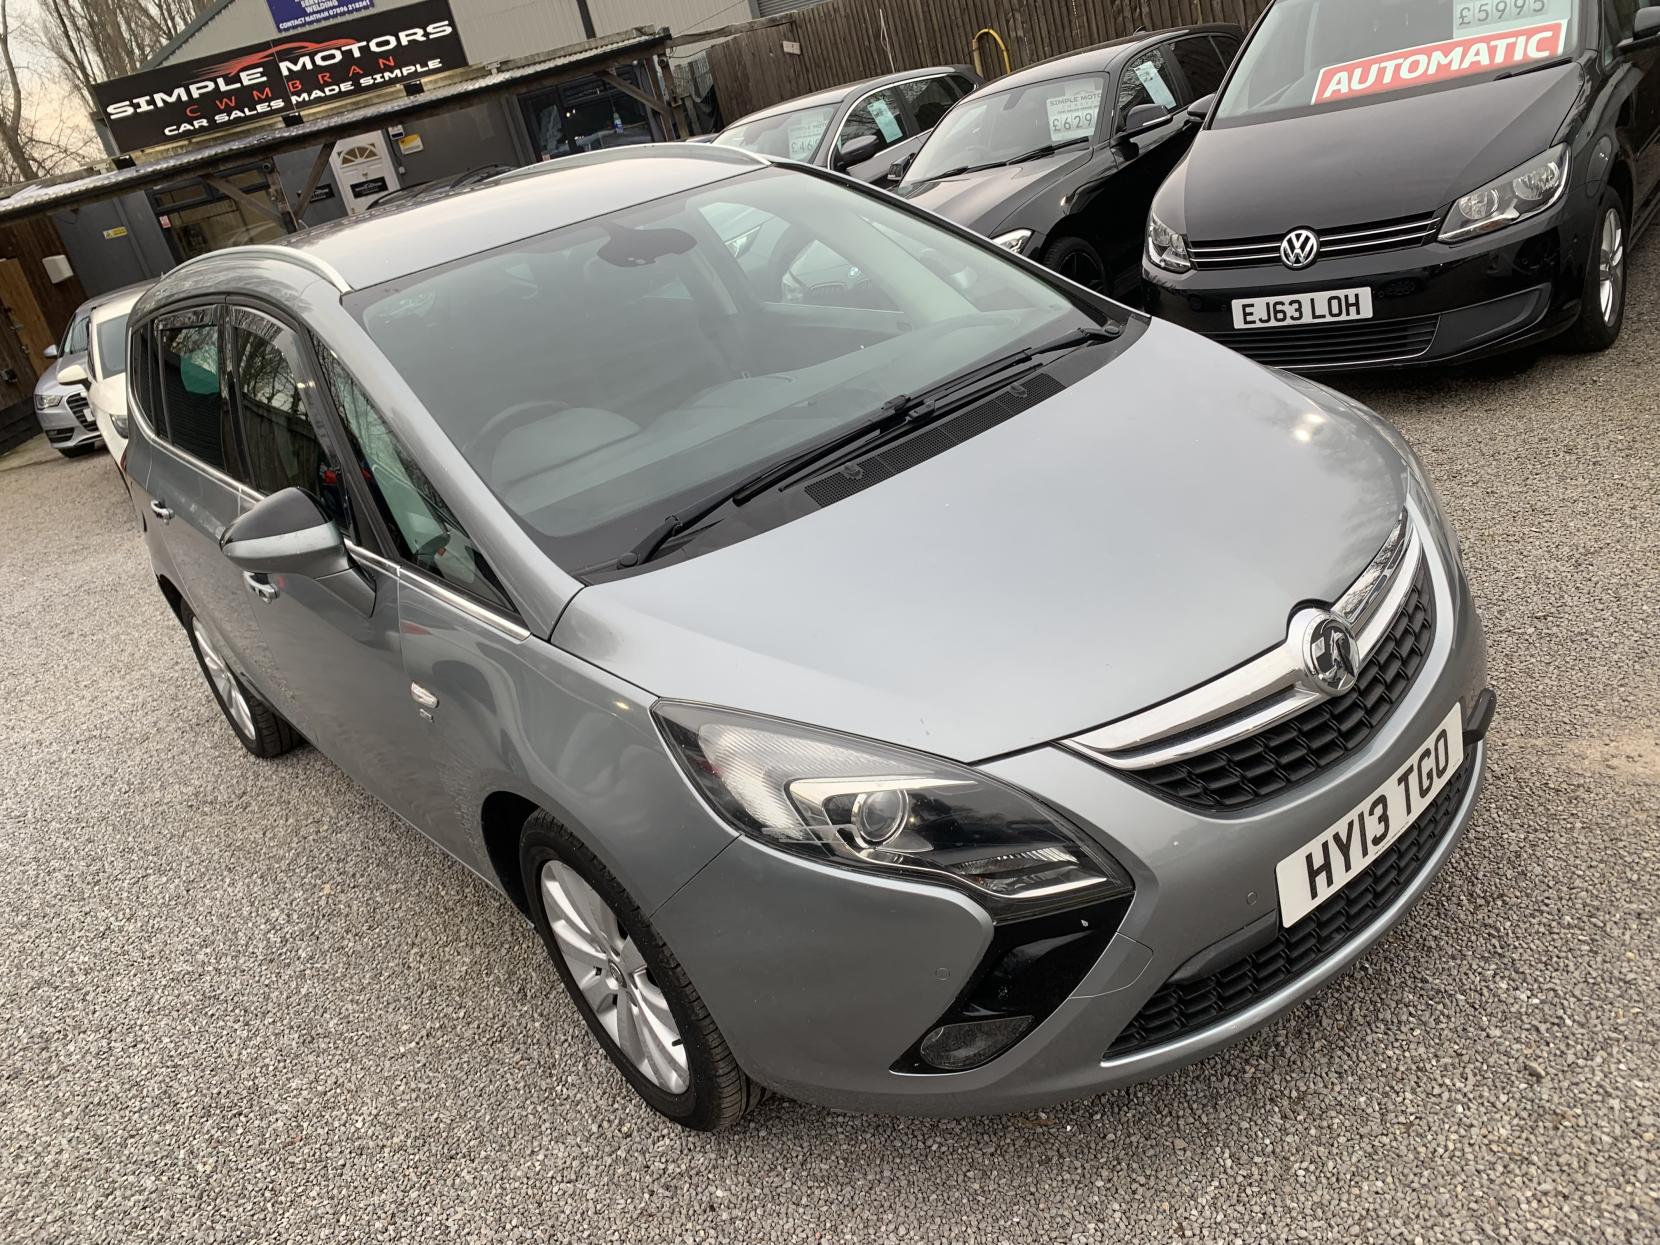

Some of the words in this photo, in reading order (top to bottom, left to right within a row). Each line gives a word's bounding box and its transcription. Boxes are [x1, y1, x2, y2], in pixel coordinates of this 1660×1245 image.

[279, 17, 306, 29] CONTACT
[305, 11, 329, 22] NATHAN
[304, 0, 339, 14] WELDING
[1458, 0, 1545, 26] £5995
[106, 67, 267, 120] SIMPLE
[278, 20, 453, 76] MOTORS
[1323, 31, 1553, 98] AUTOMATIC
[164, 118, 209, 136] CAR
[214, 98, 285, 124] SALES
[292, 81, 355, 104] MADE
[359, 58, 443, 87] SIMPLE
[186, 56, 396, 117] CWMBRAN
[1080, 91, 1102, 101] MOTO
[1052, 112, 1093, 132] £629
[1241, 300, 1304, 325] EJ63
[1310, 293, 1361, 319] LOH
[1305, 794, 1390, 900] HY13
[1397, 729, 1449, 817] TGO
